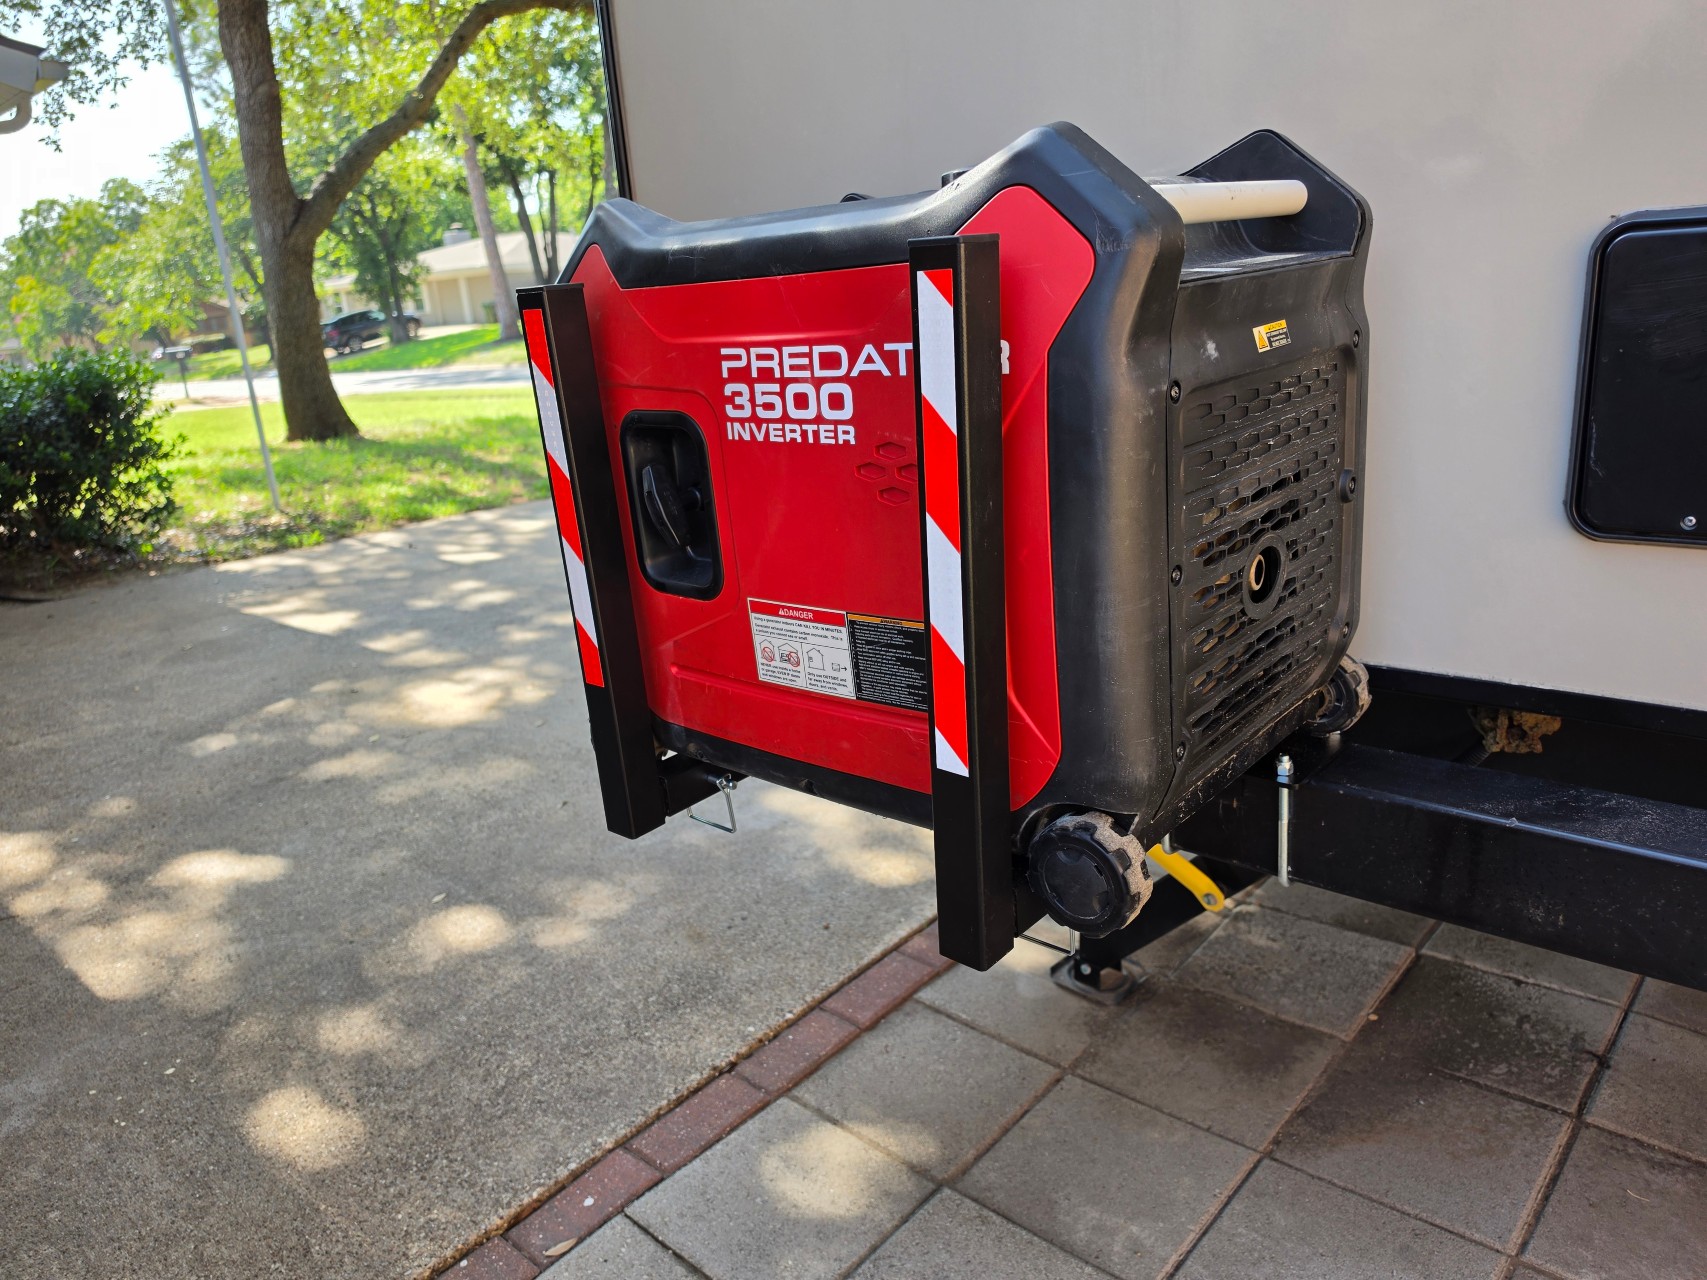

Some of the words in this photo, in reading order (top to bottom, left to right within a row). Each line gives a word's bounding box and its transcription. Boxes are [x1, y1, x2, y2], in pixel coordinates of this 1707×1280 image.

[724, 382, 854, 420] 3500
[726, 422, 856, 445] INVERTER
[783, 608, 813, 619] DANGER
